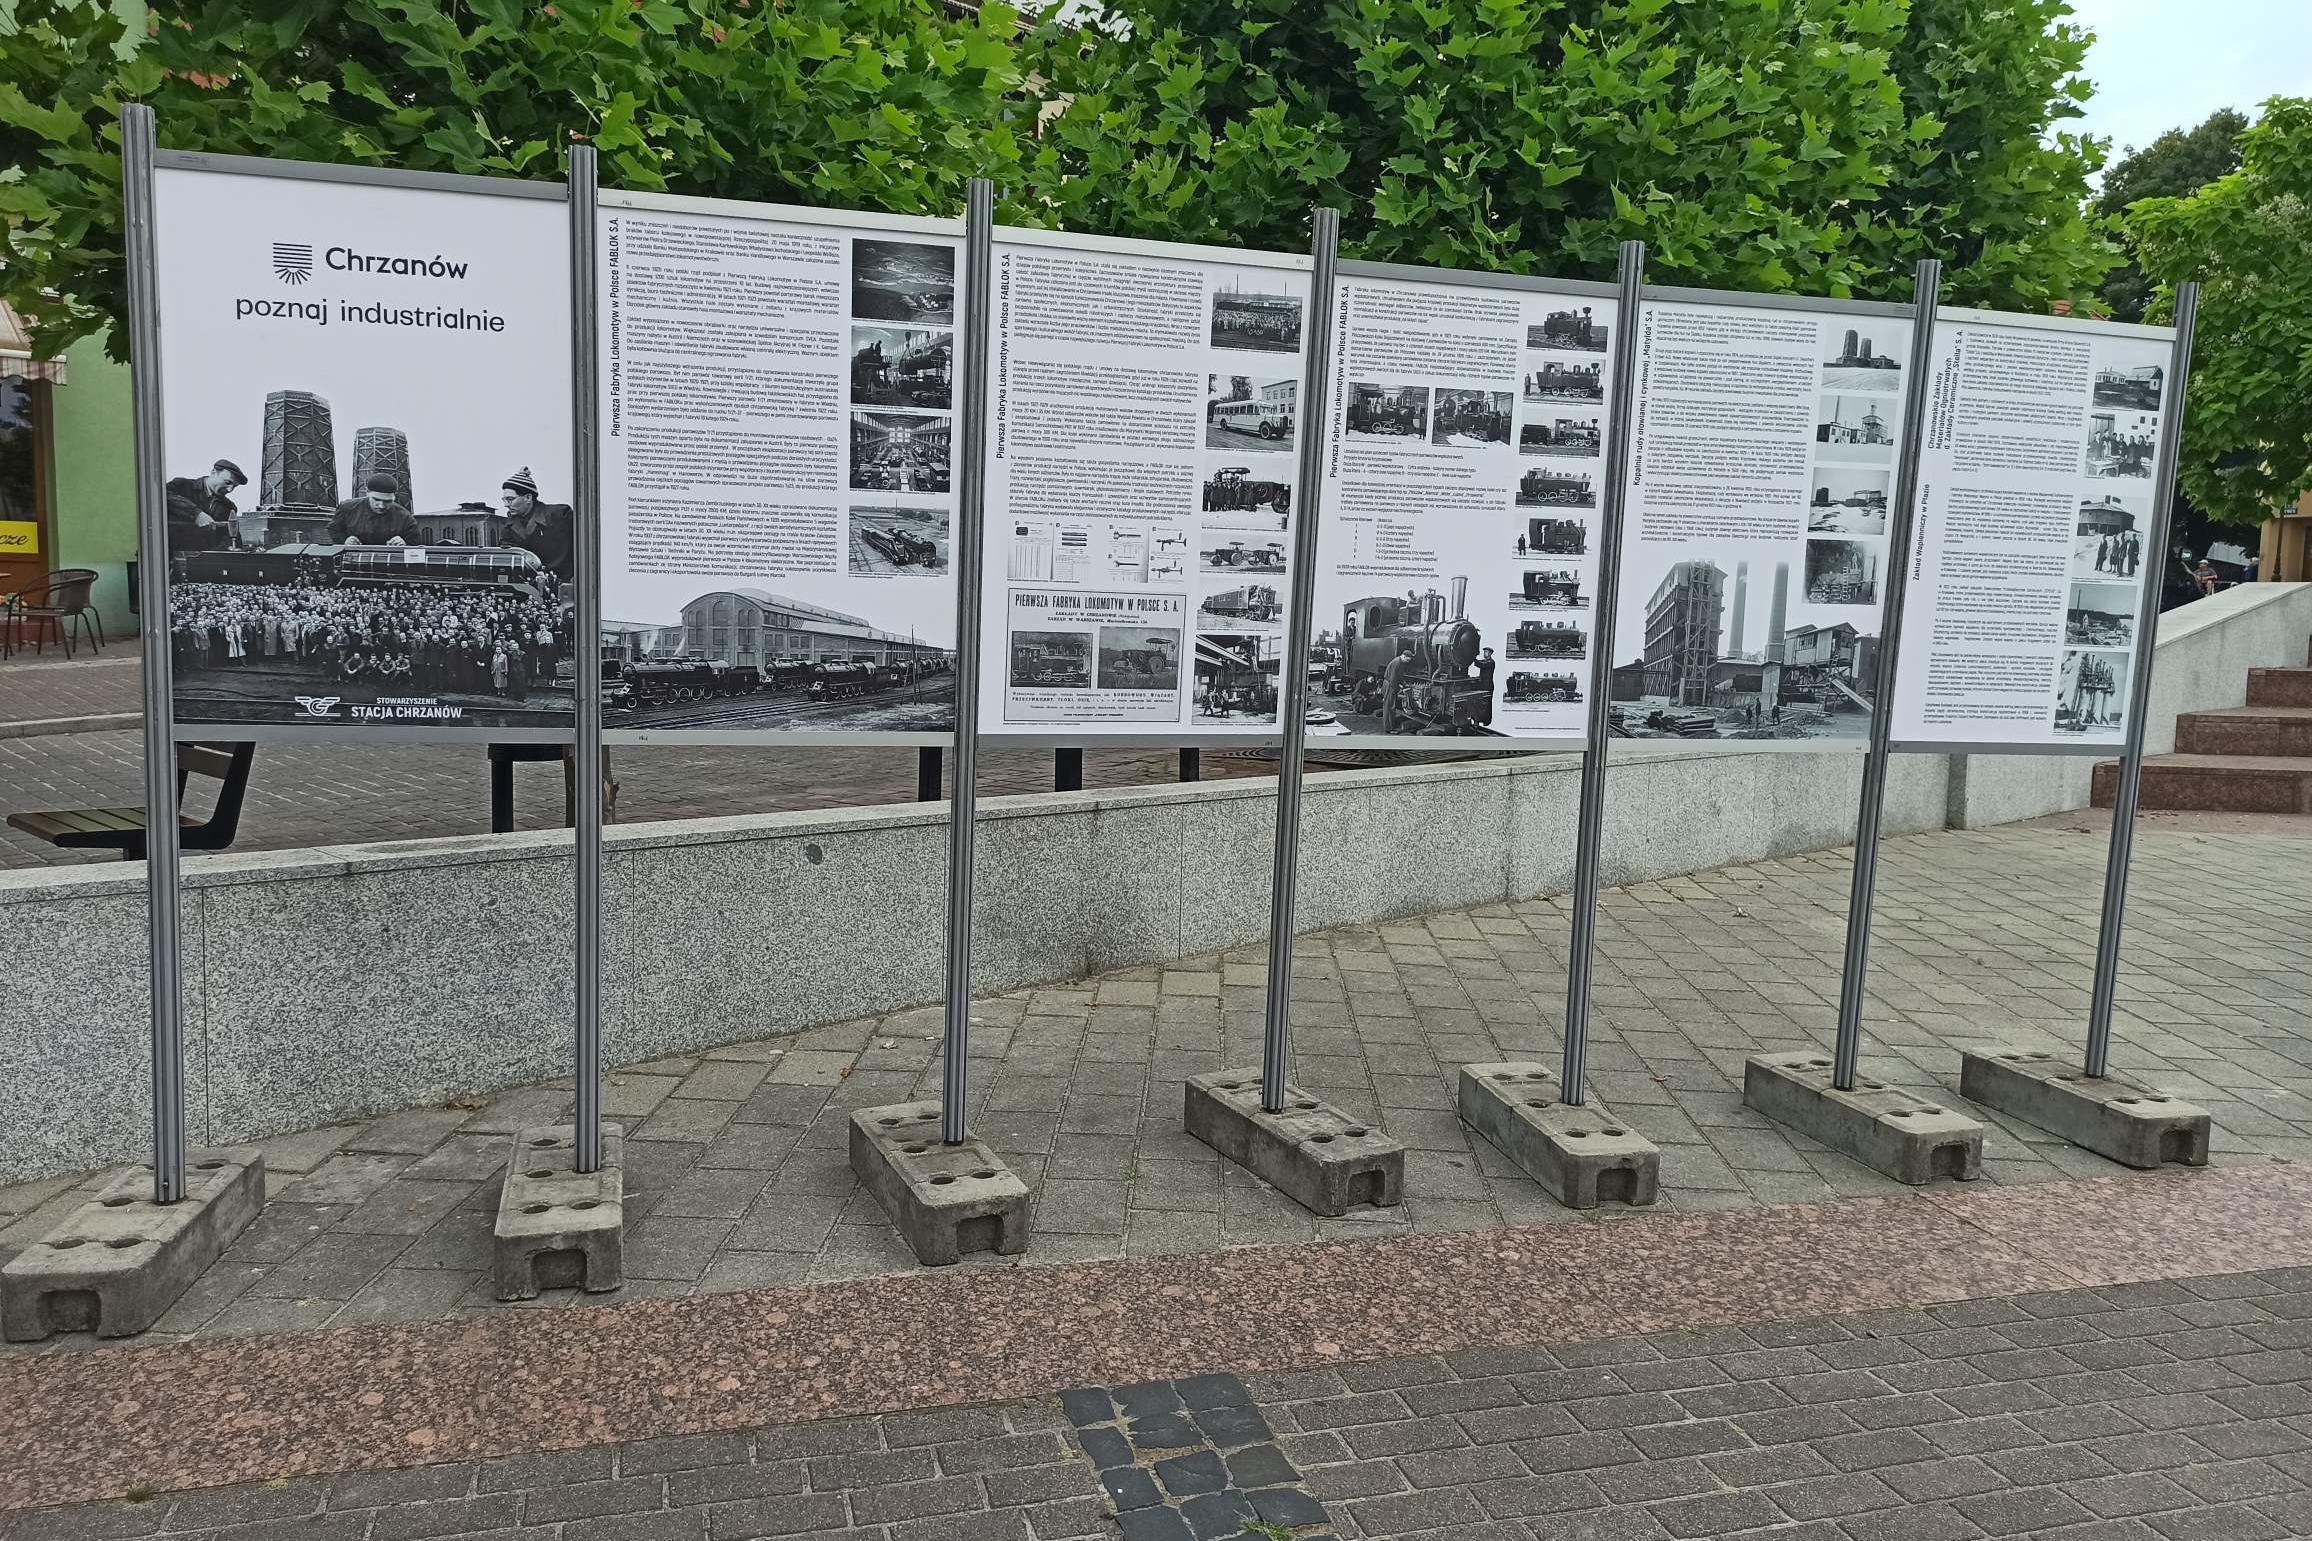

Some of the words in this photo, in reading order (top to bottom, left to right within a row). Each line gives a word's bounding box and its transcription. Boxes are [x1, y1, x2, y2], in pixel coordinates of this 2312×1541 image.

[609, 217, 619, 232] S.A.
[326, 247, 468, 279] Chrzanów
[610, 234, 619, 268] FABLOK
[1001, 253, 1010, 267] S.A.
[610, 269, 619, 298] Polsce
[1000, 269, 1009, 300] FABLOK
[236, 298, 327, 325] poznaj
[341, 299, 505, 332] industrialnie
[1000, 301, 1009, 329] Polsce
[1339, 299, 1349, 329] FABLOK
[610, 308, 621, 359] Lokomotyw
[1338, 331, 1346, 356] Polsce
[611, 361, 622, 396] Fabryka
[999, 340, 1009, 386] Lokomotyw
[1641, 360, 1650, 395] cynkowej
[998, 388, 1007, 421] Fabryka
[1335, 367, 1345, 411] Lokomotyw
[611, 399, 620, 437] Pierwsza
[1639, 399, 1647, 435] ołowianej
[1928, 401, 1940, 449] Chrzanowskie
[1934, 372, 1942, 399] Zakłady
[996, 423, 1006, 459] Pierwsza
[1332, 412, 1342, 442] Fabryka
[1936, 410, 1946, 449] Materiałów
[1329, 445, 1339, 477] Pierwsza
[1637, 436, 1645, 454] rudy
[1633, 455, 1642, 486] Kopalnia
[1916, 514, 1927, 556] Wapienniczy
[1913, 558, 1921, 581] Zakład
[1015, 594, 1049, 608] PIERWSZA
[1052, 596, 1081, 609] FABRYKA
[1085, 597, 1124, 610] LOKOMOTYW
[1128, 598, 1133, 611] W
[1137, 599, 1160, 612] POLSCE
[351, 706, 394, 720] STACJA
[396, 705, 462, 718] CHRZANÓW
[376, 697, 437, 705] STOWARZYSZENIE
